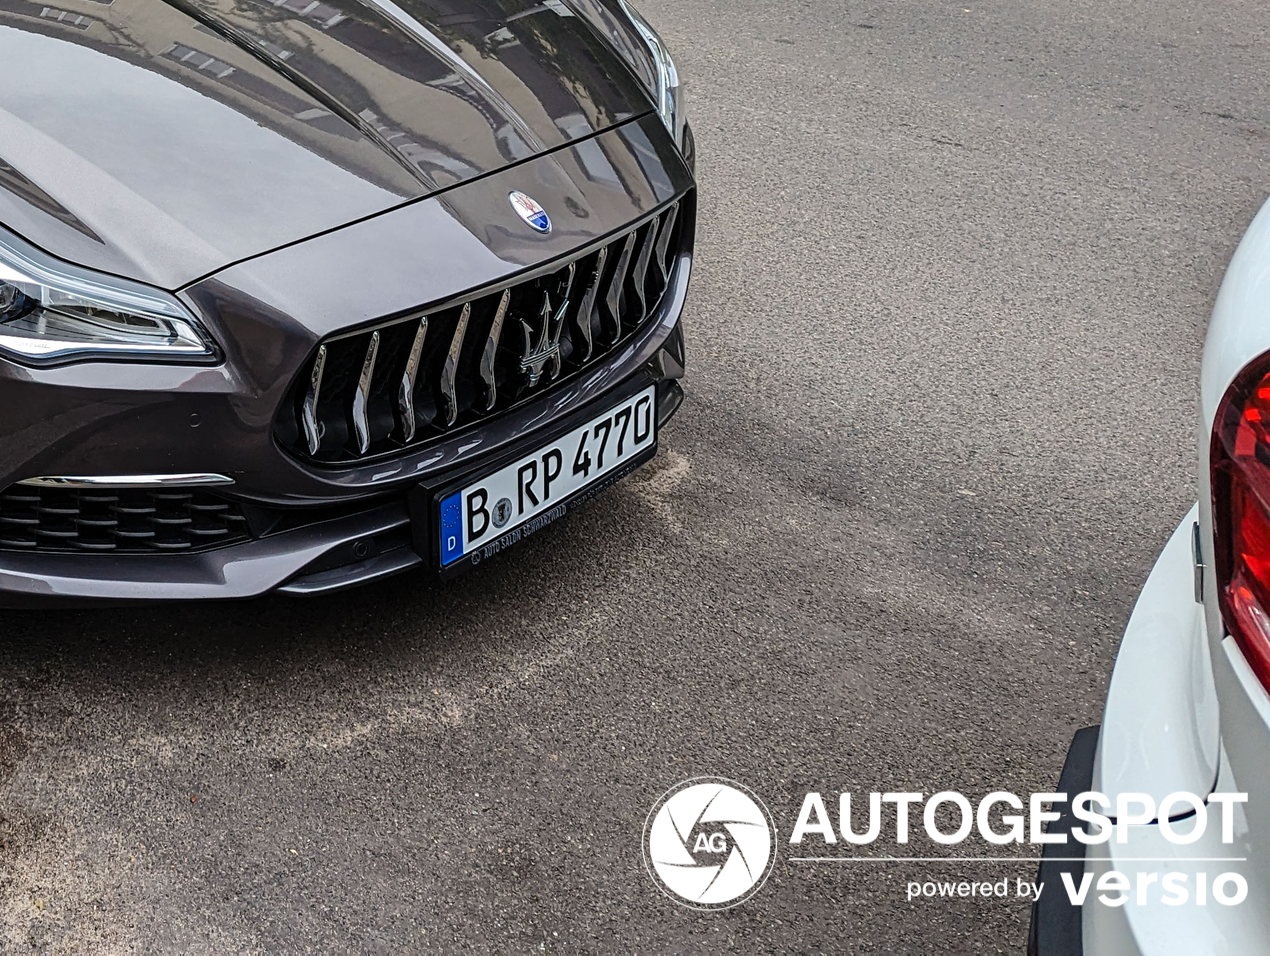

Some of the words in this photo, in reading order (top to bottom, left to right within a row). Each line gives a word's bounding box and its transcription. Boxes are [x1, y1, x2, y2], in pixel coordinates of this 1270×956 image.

[447, 535, 456, 552] D
[466, 487, 490, 545] B
[517, 447, 562, 516] RP
[572, 394, 651, 478] 4770
[484, 542, 501, 559] AUTO
[501, 532, 522, 550] SALON
[523, 504, 567, 538] SCHWARZWALD
